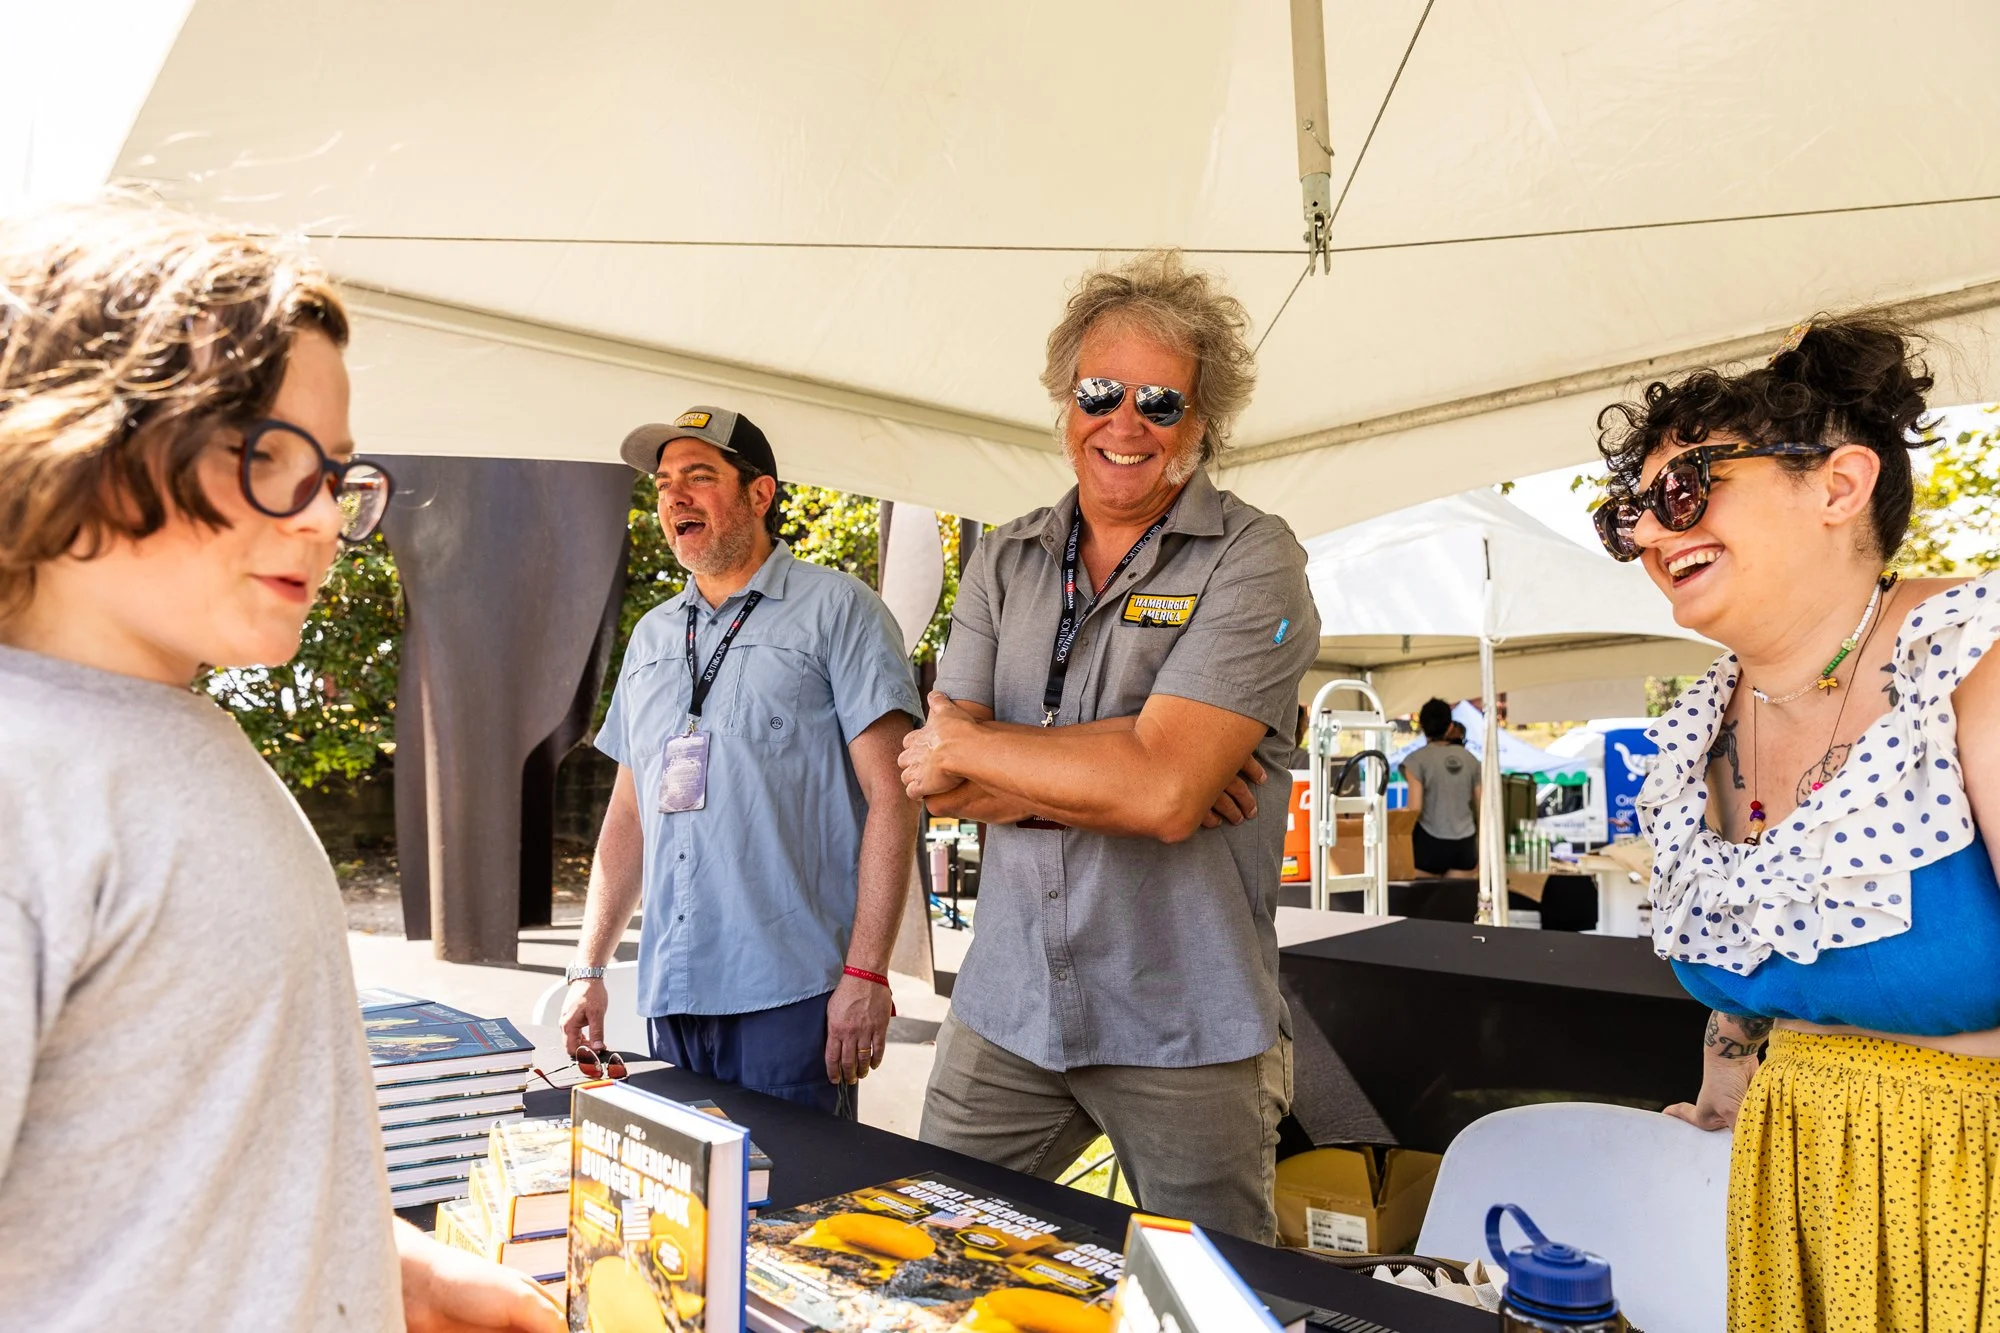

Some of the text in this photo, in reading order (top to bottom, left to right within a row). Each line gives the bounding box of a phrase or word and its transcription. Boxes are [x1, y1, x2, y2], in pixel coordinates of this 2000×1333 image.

[1135, 598, 1190, 610] HAMBURGER
[1140, 609, 1180, 621] AMERICA
[581, 1119, 691, 1194] GREAT AMERICAN
[581, 1147, 641, 1201] BURGER
[642, 1175, 690, 1228] BOOK
[917, 1180, 1061, 1234] GREAT AMERICAN
[896, 1185, 980, 1218] BURGER
[975, 1214, 1042, 1241] BOOK
[1053, 1250, 1125, 1280] BURG
[1074, 1244, 1127, 1268] GREA
